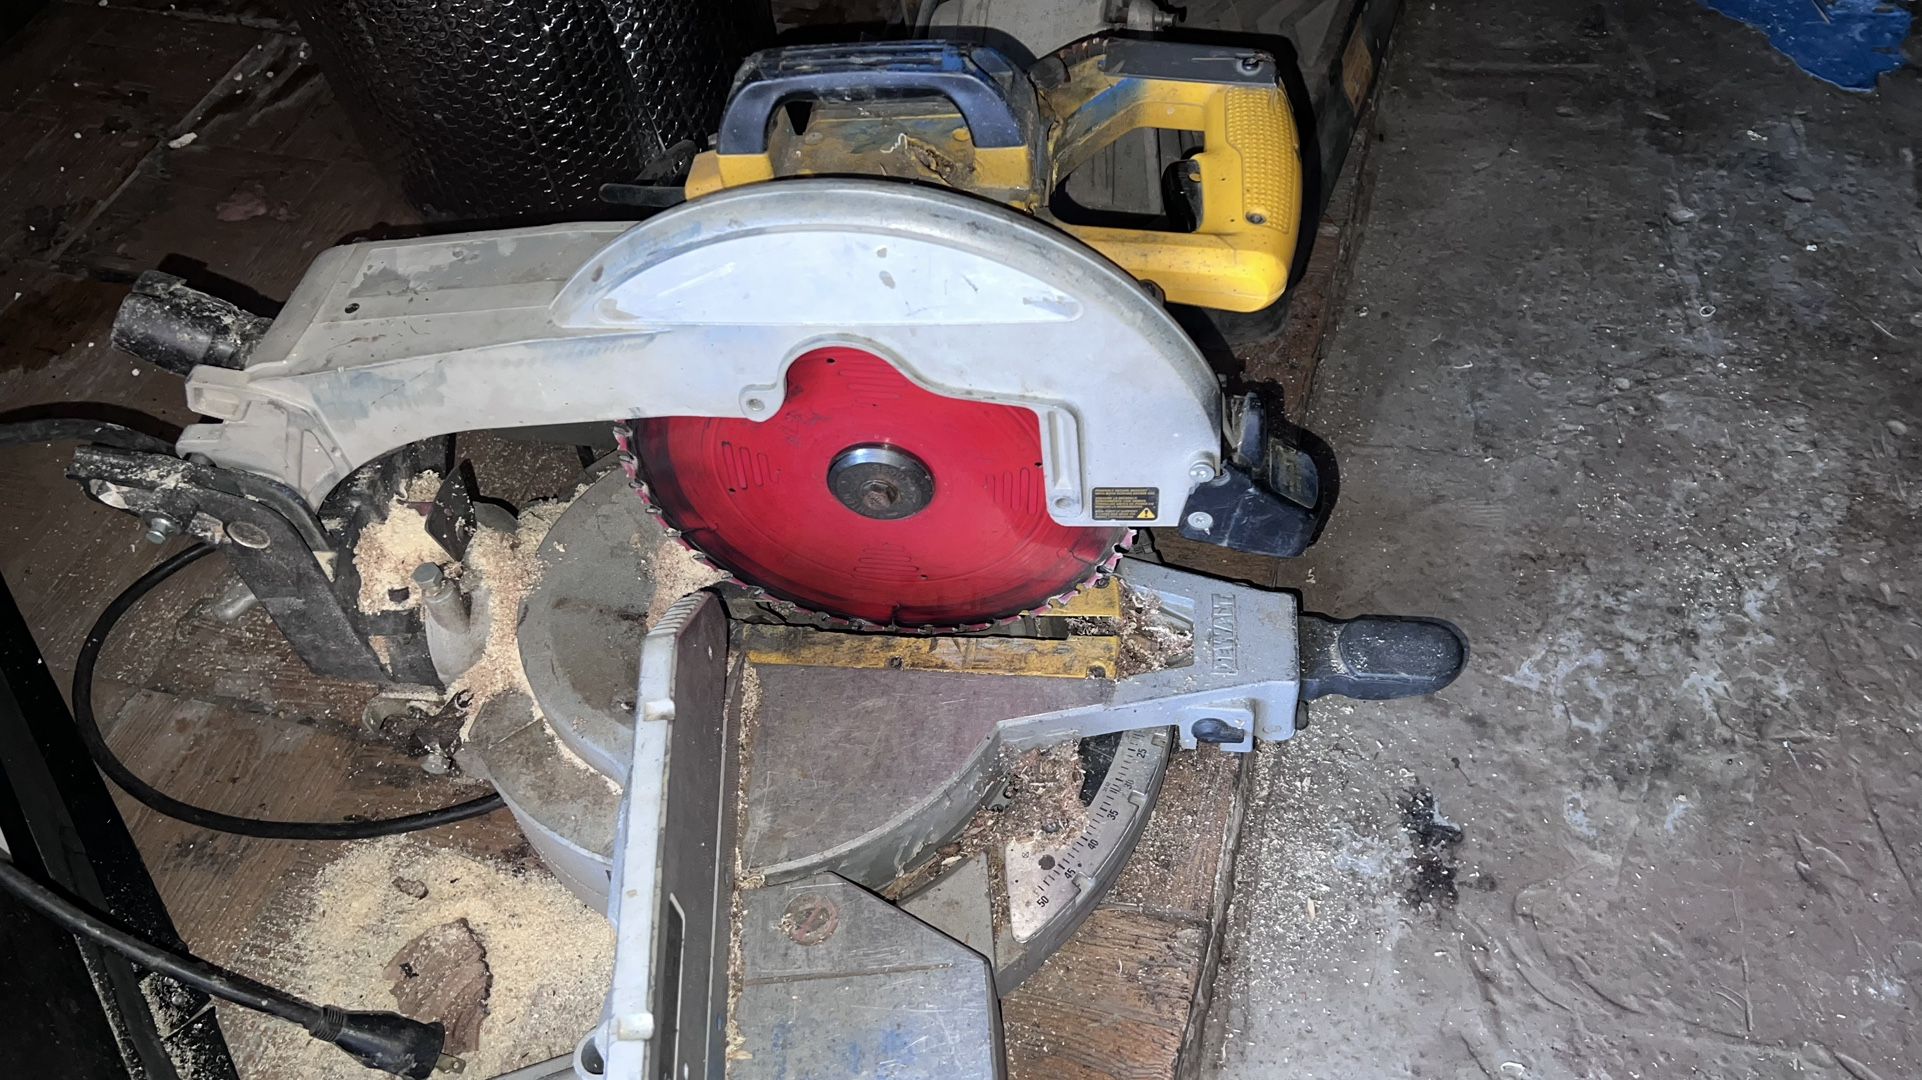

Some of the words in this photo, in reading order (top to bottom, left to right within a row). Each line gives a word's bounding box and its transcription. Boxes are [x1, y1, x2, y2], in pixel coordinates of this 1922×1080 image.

[1136, 748, 1147, 759] 25
[1124, 780, 1135, 790] 30
[1106, 809, 1119, 820] 35
[1087, 839, 1099, 850] 40
[1064, 868, 1076, 879] 45
[1036, 895, 1049, 907] 50
